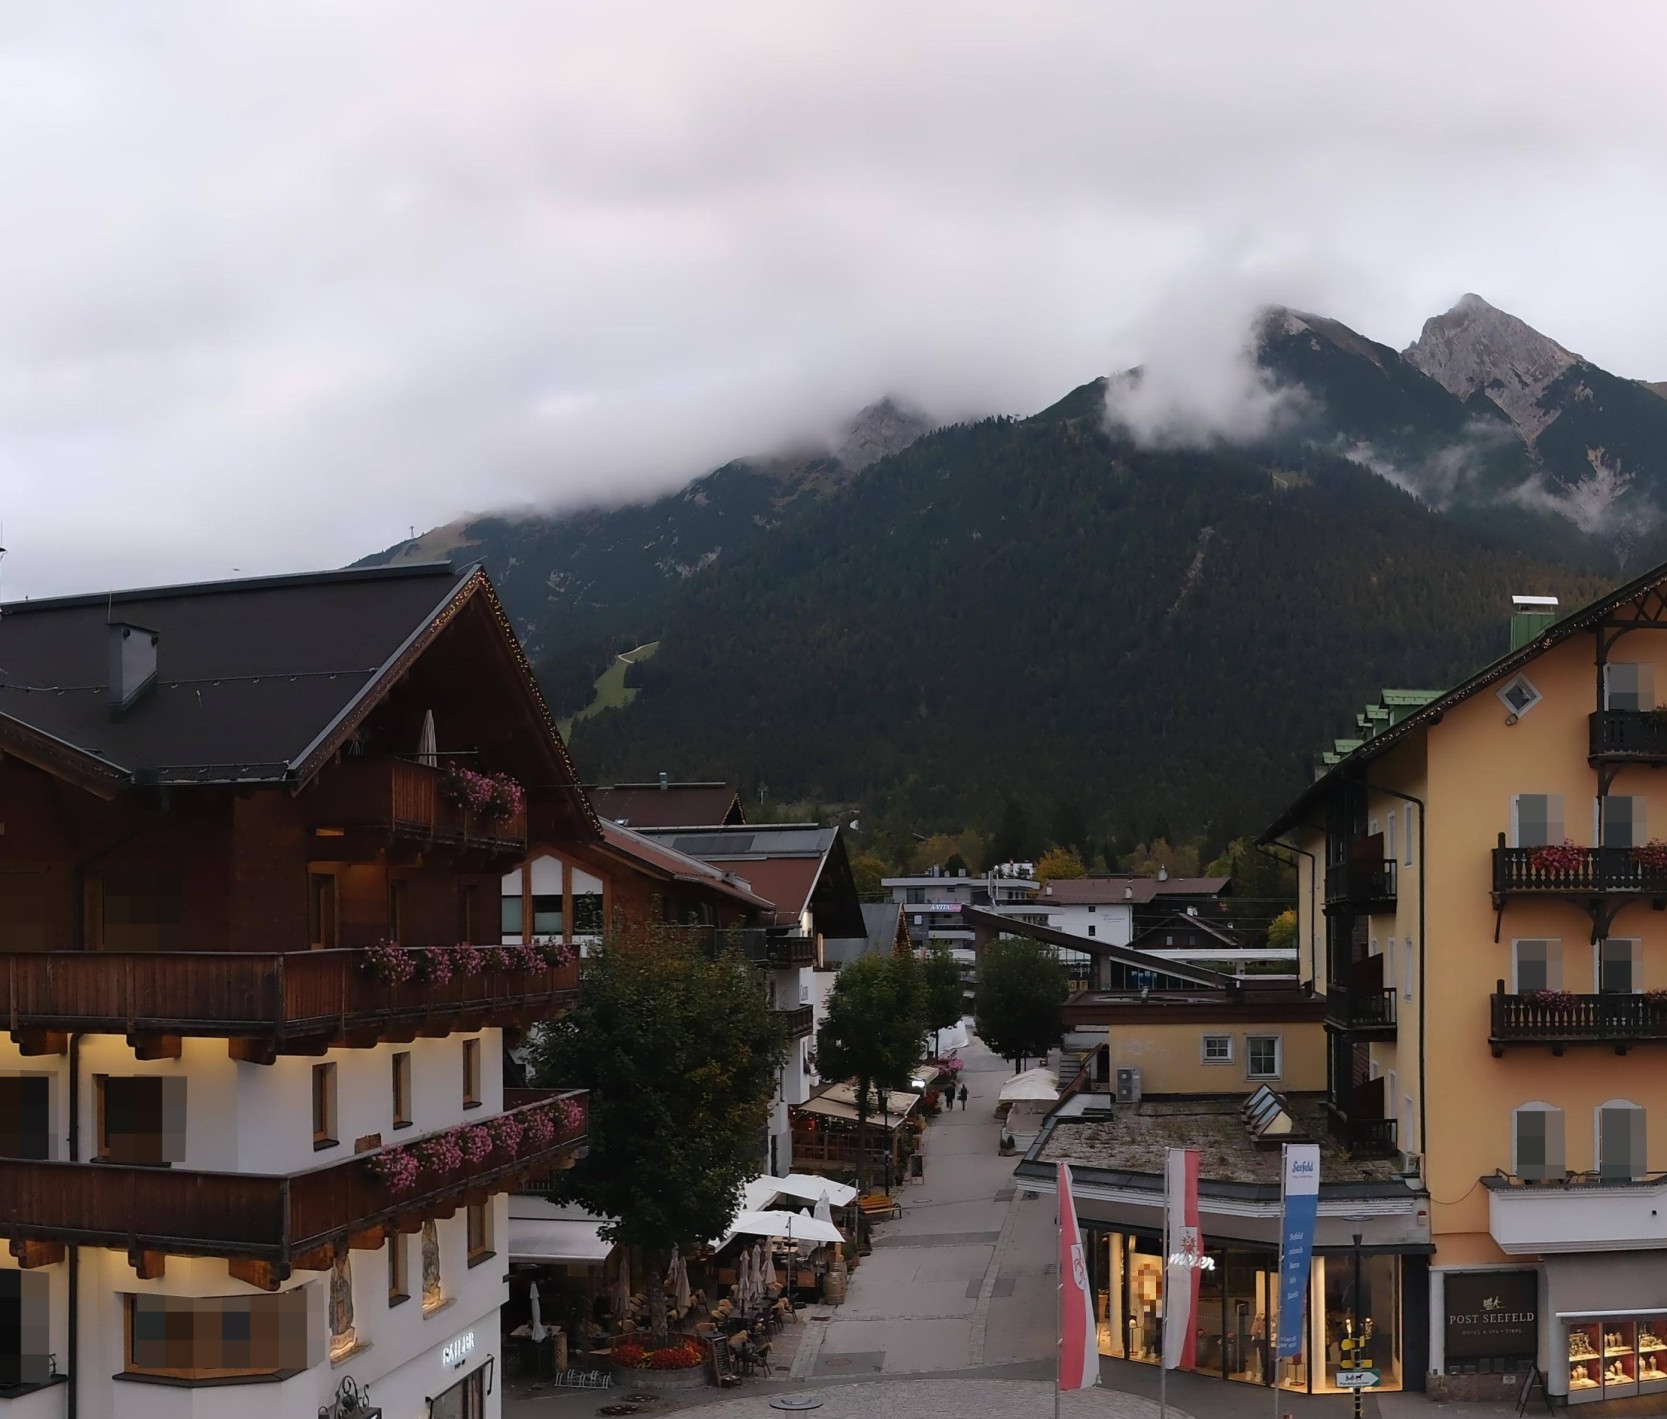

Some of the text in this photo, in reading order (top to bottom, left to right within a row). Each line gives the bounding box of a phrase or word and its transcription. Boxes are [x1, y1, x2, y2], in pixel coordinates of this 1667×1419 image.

[1292, 1160, 1314, 1173] Seefeld
[1449, 1312, 1535, 1325] POST SEEFELD
